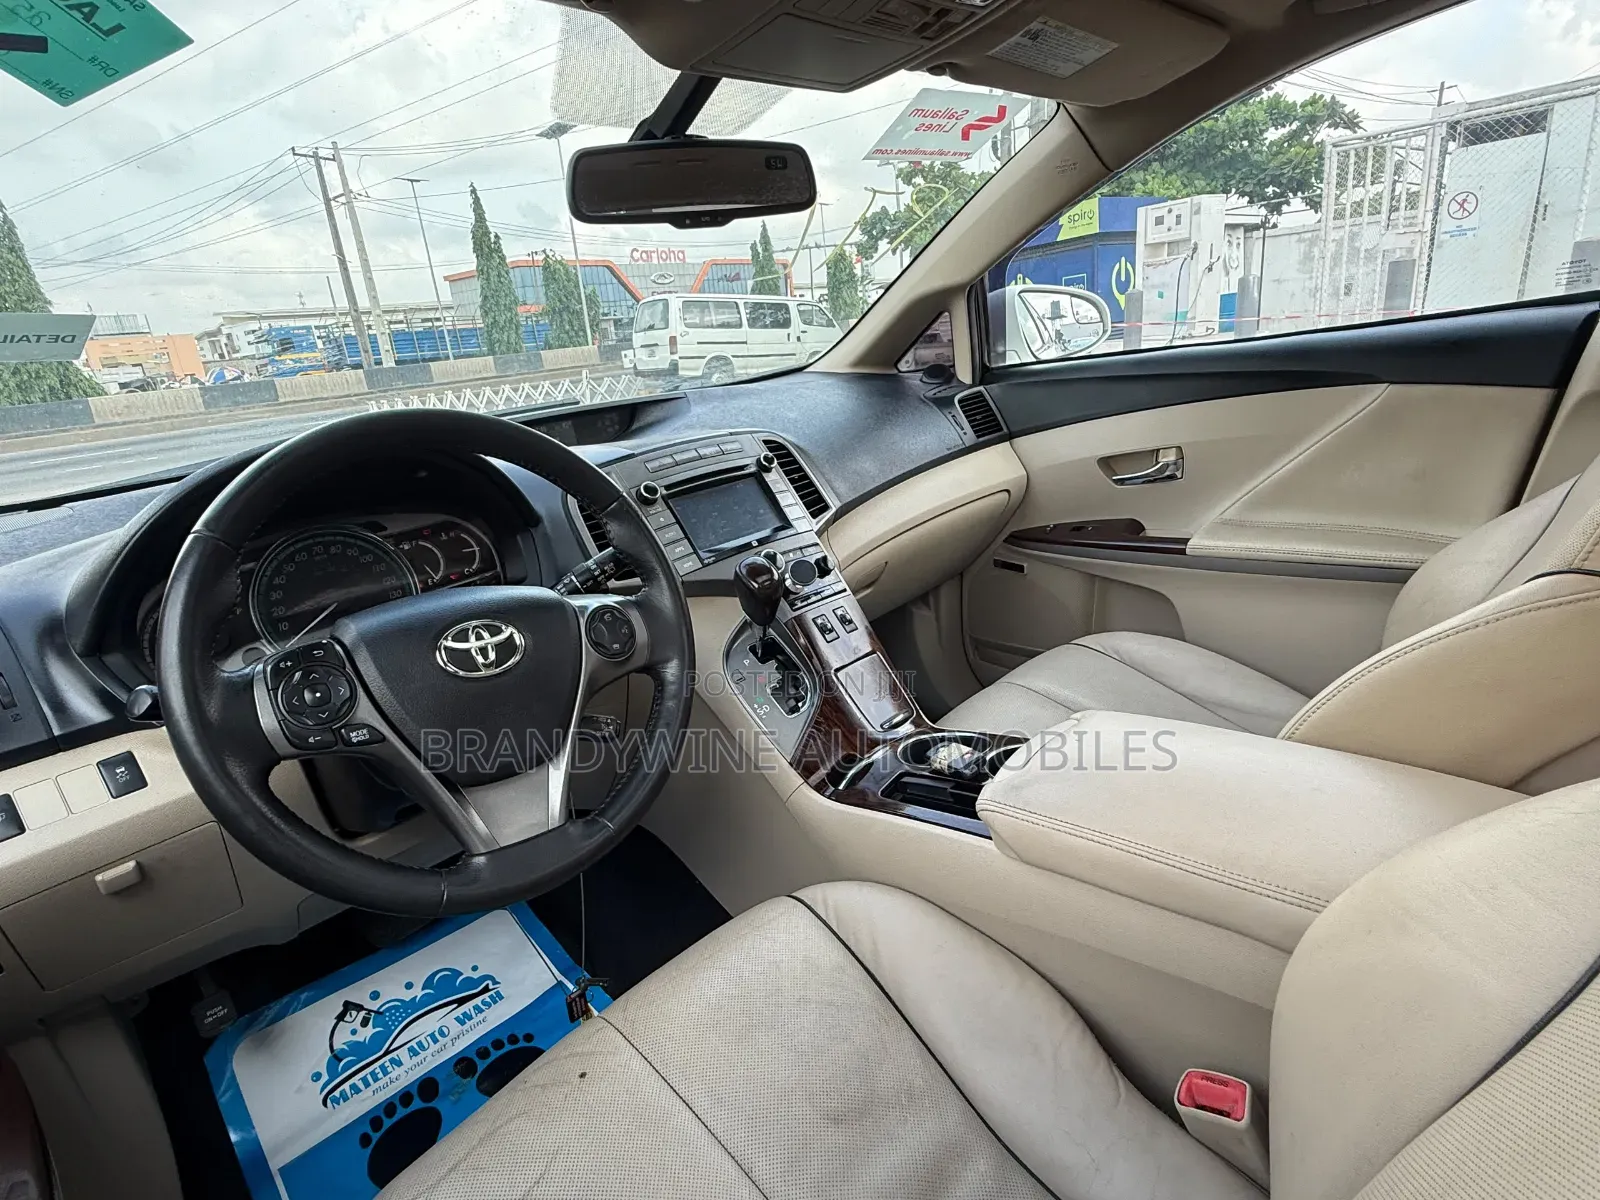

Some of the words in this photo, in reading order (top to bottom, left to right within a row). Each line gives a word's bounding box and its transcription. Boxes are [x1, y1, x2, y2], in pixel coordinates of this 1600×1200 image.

[312, 545, 324, 555] 70
[294, 552, 307, 562] 60
[269, 590, 283, 600] 30
[277, 621, 289, 631] 10
[328, 1054, 405, 1110] MATEEN
[406, 1024, 451, 1061] AUTO
[453, 989, 505, 1027] WASH
[371, 1073, 401, 1097] make
[404, 1052, 429, 1076] your
[431, 1045, 448, 1058] car
[450, 1015, 488, 1048] pristine
[1200, 1075, 1230, 1088] PRESS
